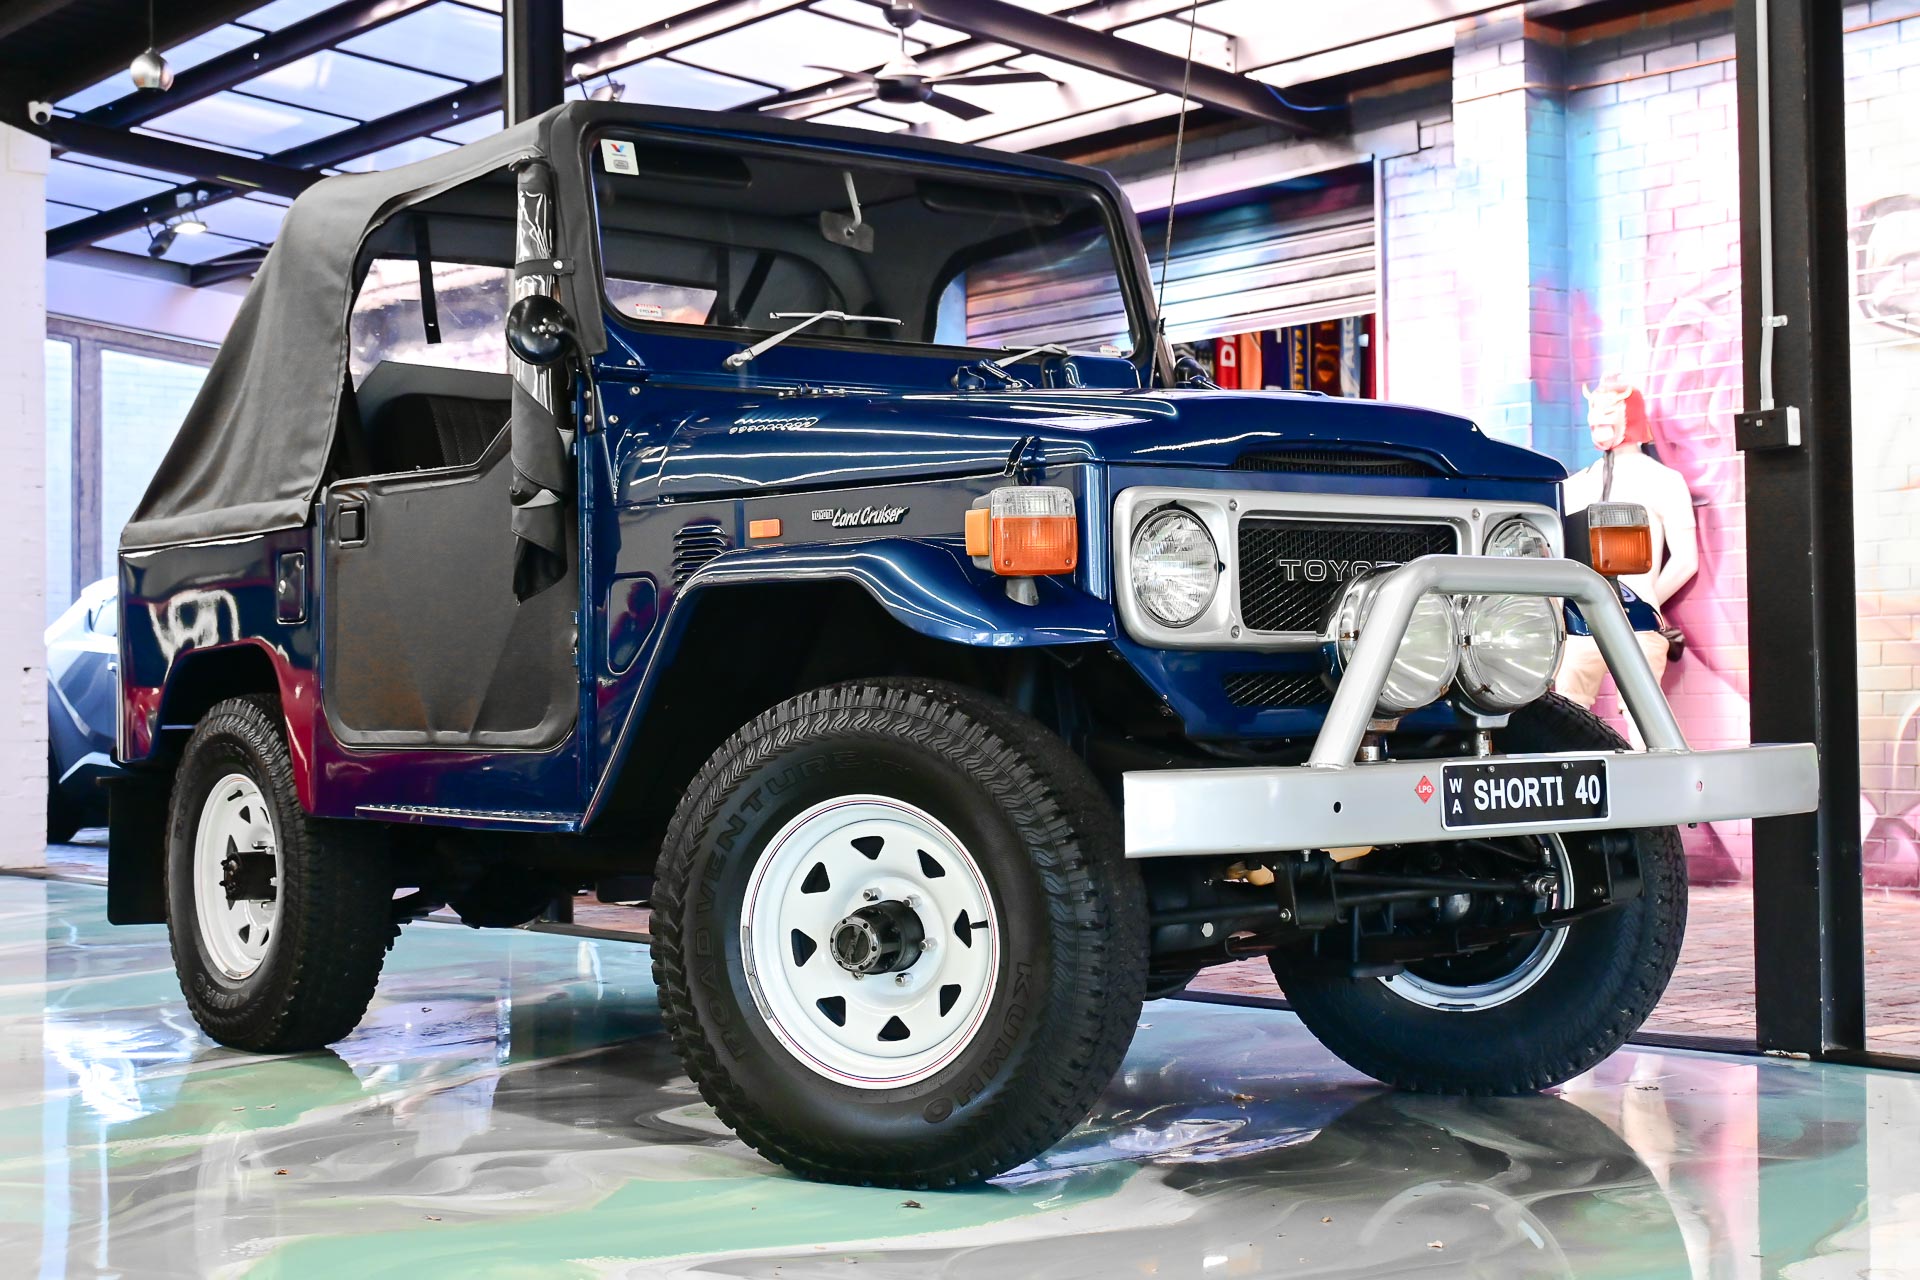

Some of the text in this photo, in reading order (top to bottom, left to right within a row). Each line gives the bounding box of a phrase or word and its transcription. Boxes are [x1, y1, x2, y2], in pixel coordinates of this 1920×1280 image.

[812, 504, 910, 526] TOYOTA Land Cruiser
[1279, 559, 1411, 582] TOY
[1418, 784, 1433, 794] LPG
[1474, 774, 1601, 811] SHORTI 40
[696, 750, 865, 1063] ROAD VENTURE
[922, 962, 1033, 1124] KUMHO
